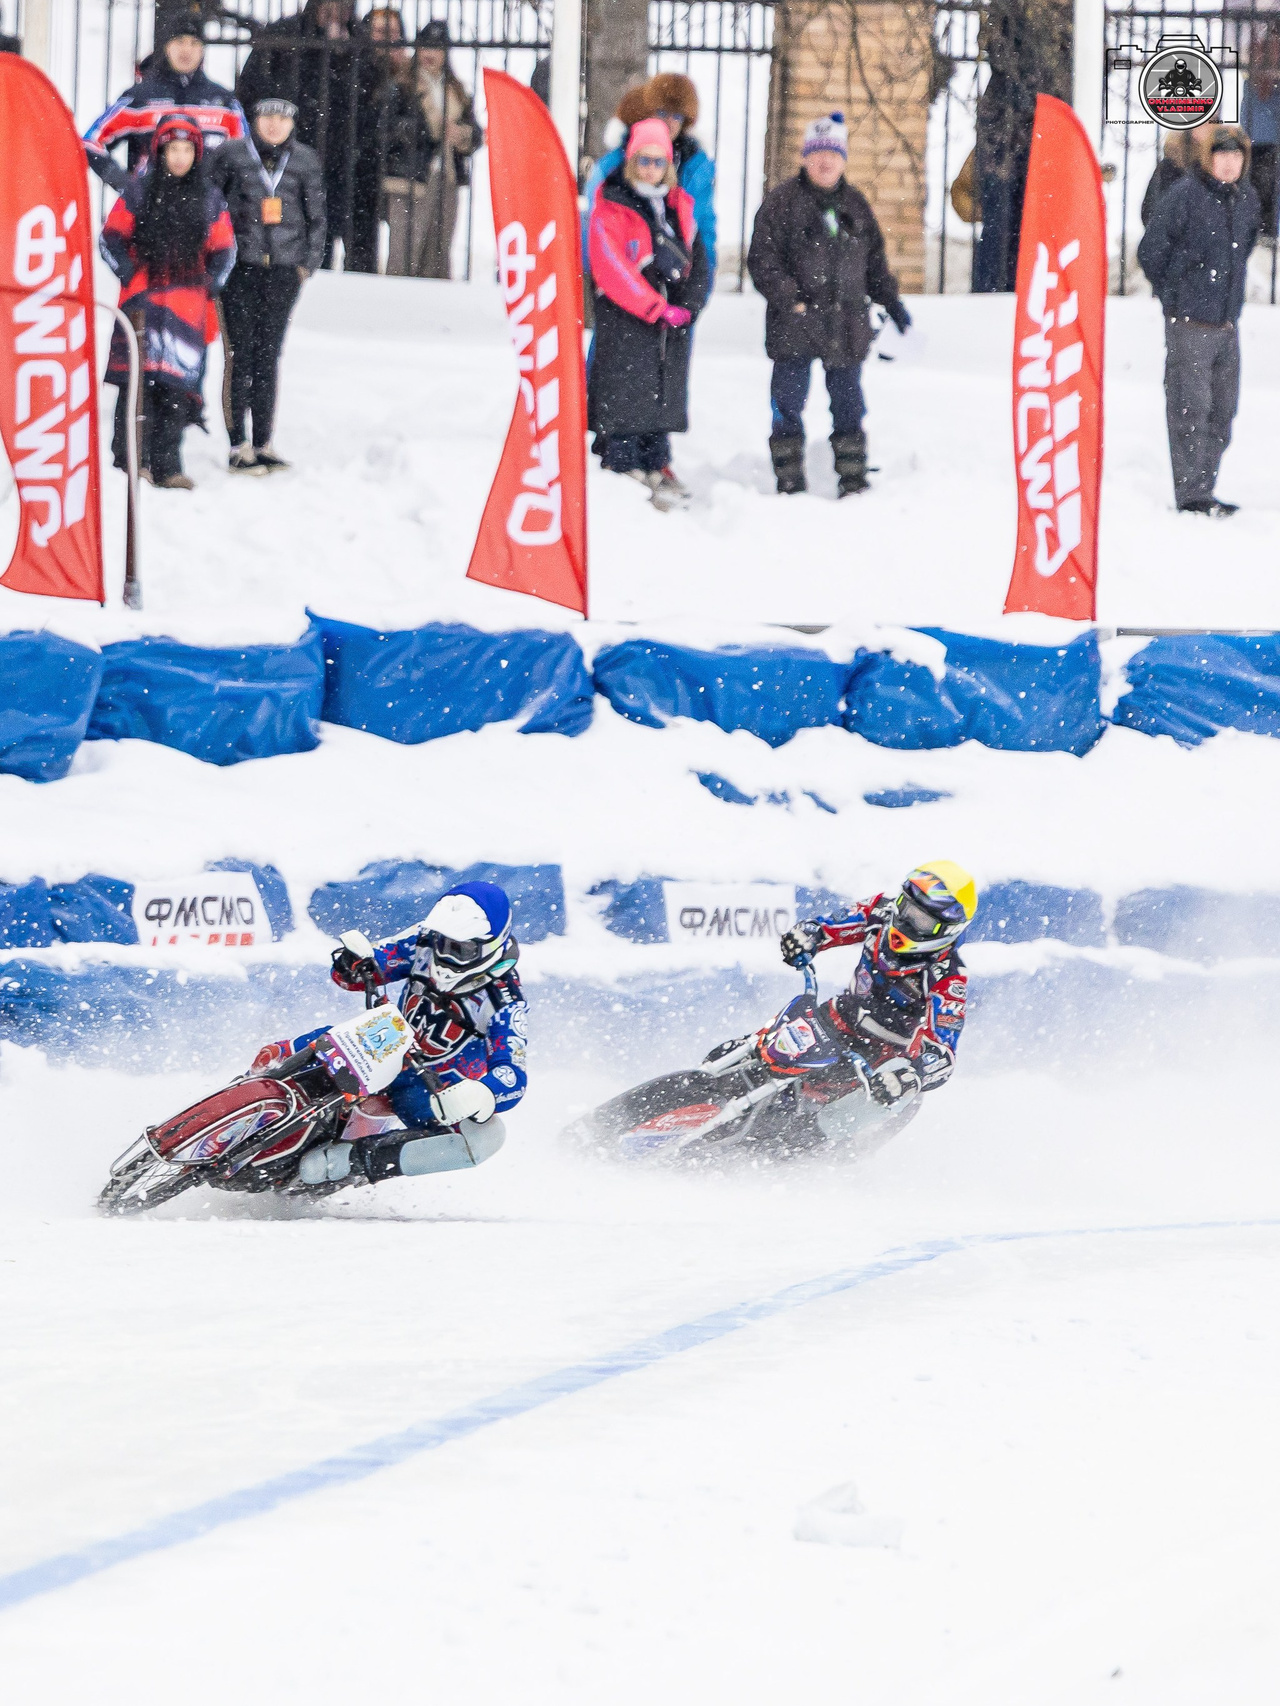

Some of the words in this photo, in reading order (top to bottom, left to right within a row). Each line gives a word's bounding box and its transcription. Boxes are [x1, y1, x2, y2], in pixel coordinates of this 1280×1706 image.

[145, 896, 255, 928] ФМСМО
[679, 907, 790, 937] ФМСМО
[343, 1031, 373, 1073] Правительство
[354, 1058, 370, 1082] области
